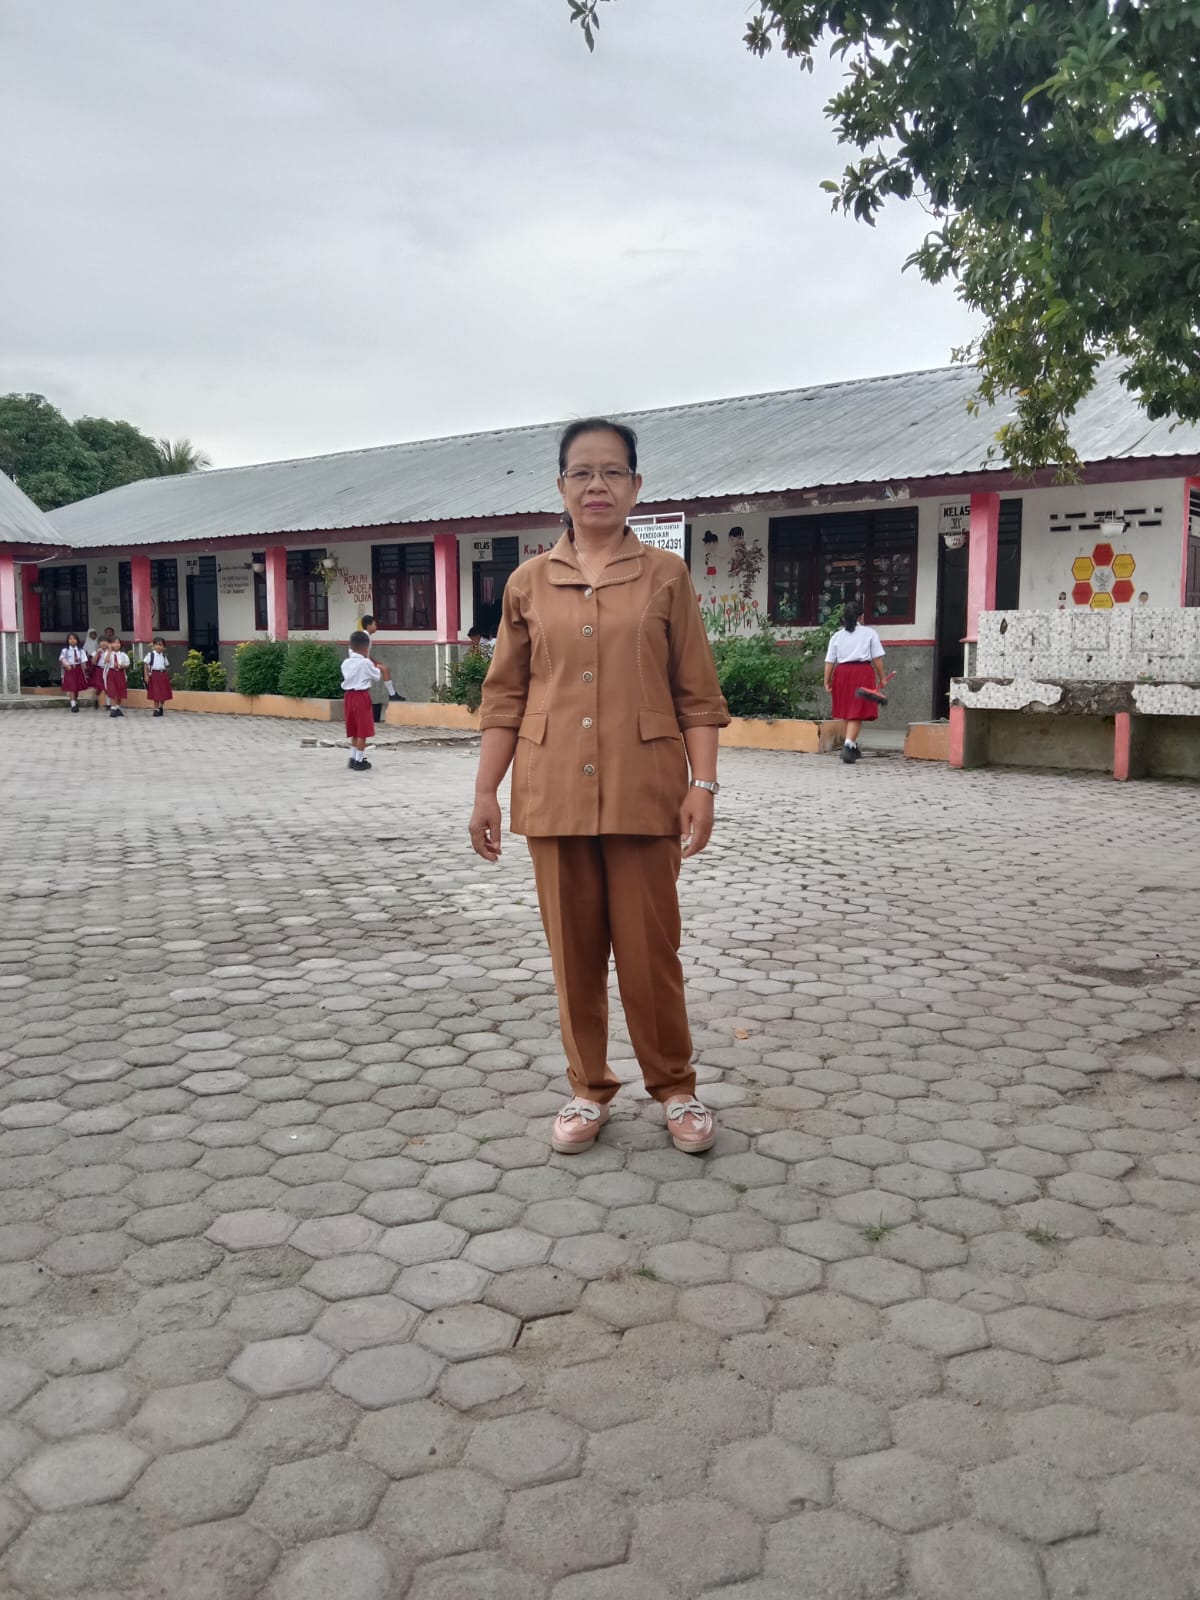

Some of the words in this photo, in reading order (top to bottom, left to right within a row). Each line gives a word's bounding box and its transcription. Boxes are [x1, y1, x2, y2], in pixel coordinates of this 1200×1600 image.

[944, 506, 971, 517] KELAS
[951, 518, 962, 529] VI
[640, 531, 669, 540] PENDIDIKAN
[474, 541, 490, 550] KELAS
[658, 538, 682, 550] 124391
